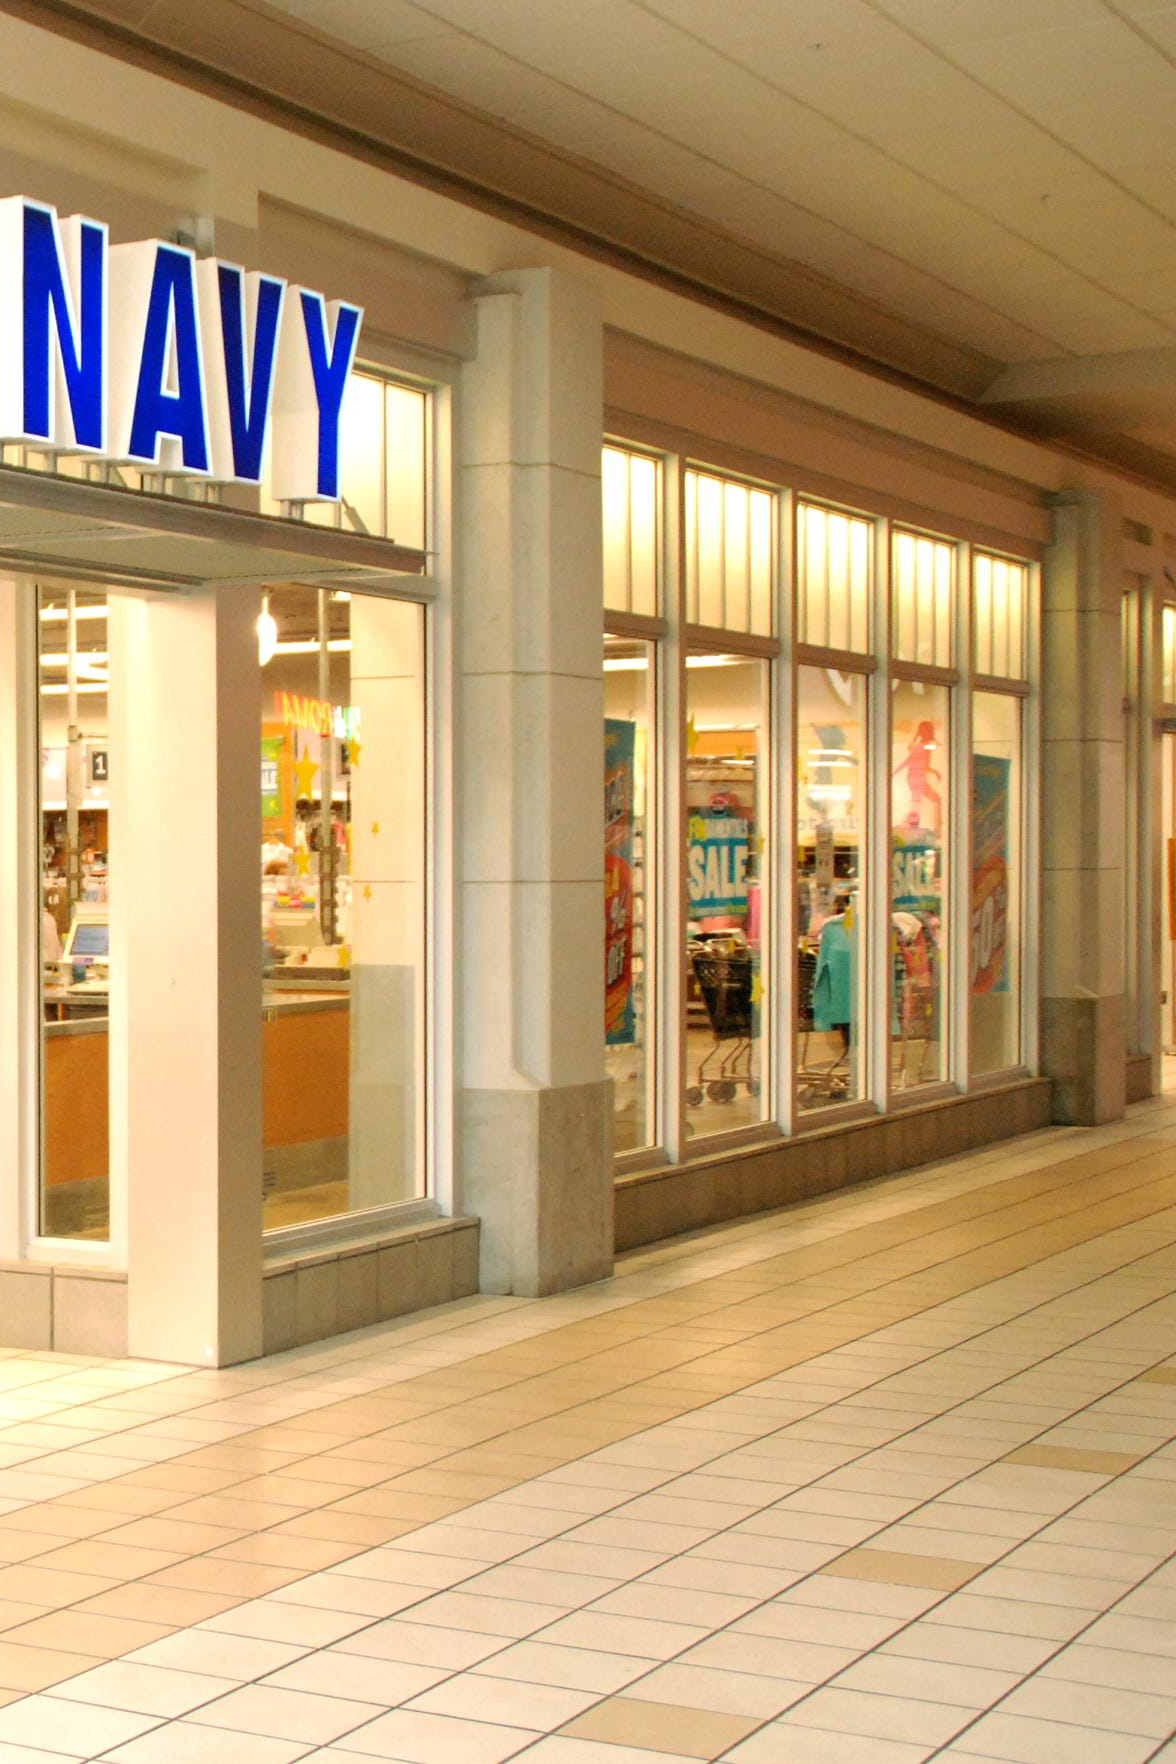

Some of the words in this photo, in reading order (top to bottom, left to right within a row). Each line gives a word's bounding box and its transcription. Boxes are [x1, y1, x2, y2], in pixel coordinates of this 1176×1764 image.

[22, 198, 363, 501] NAVY
[95, 755, 107, 775] 1
[688, 844, 748, 901] SALE
